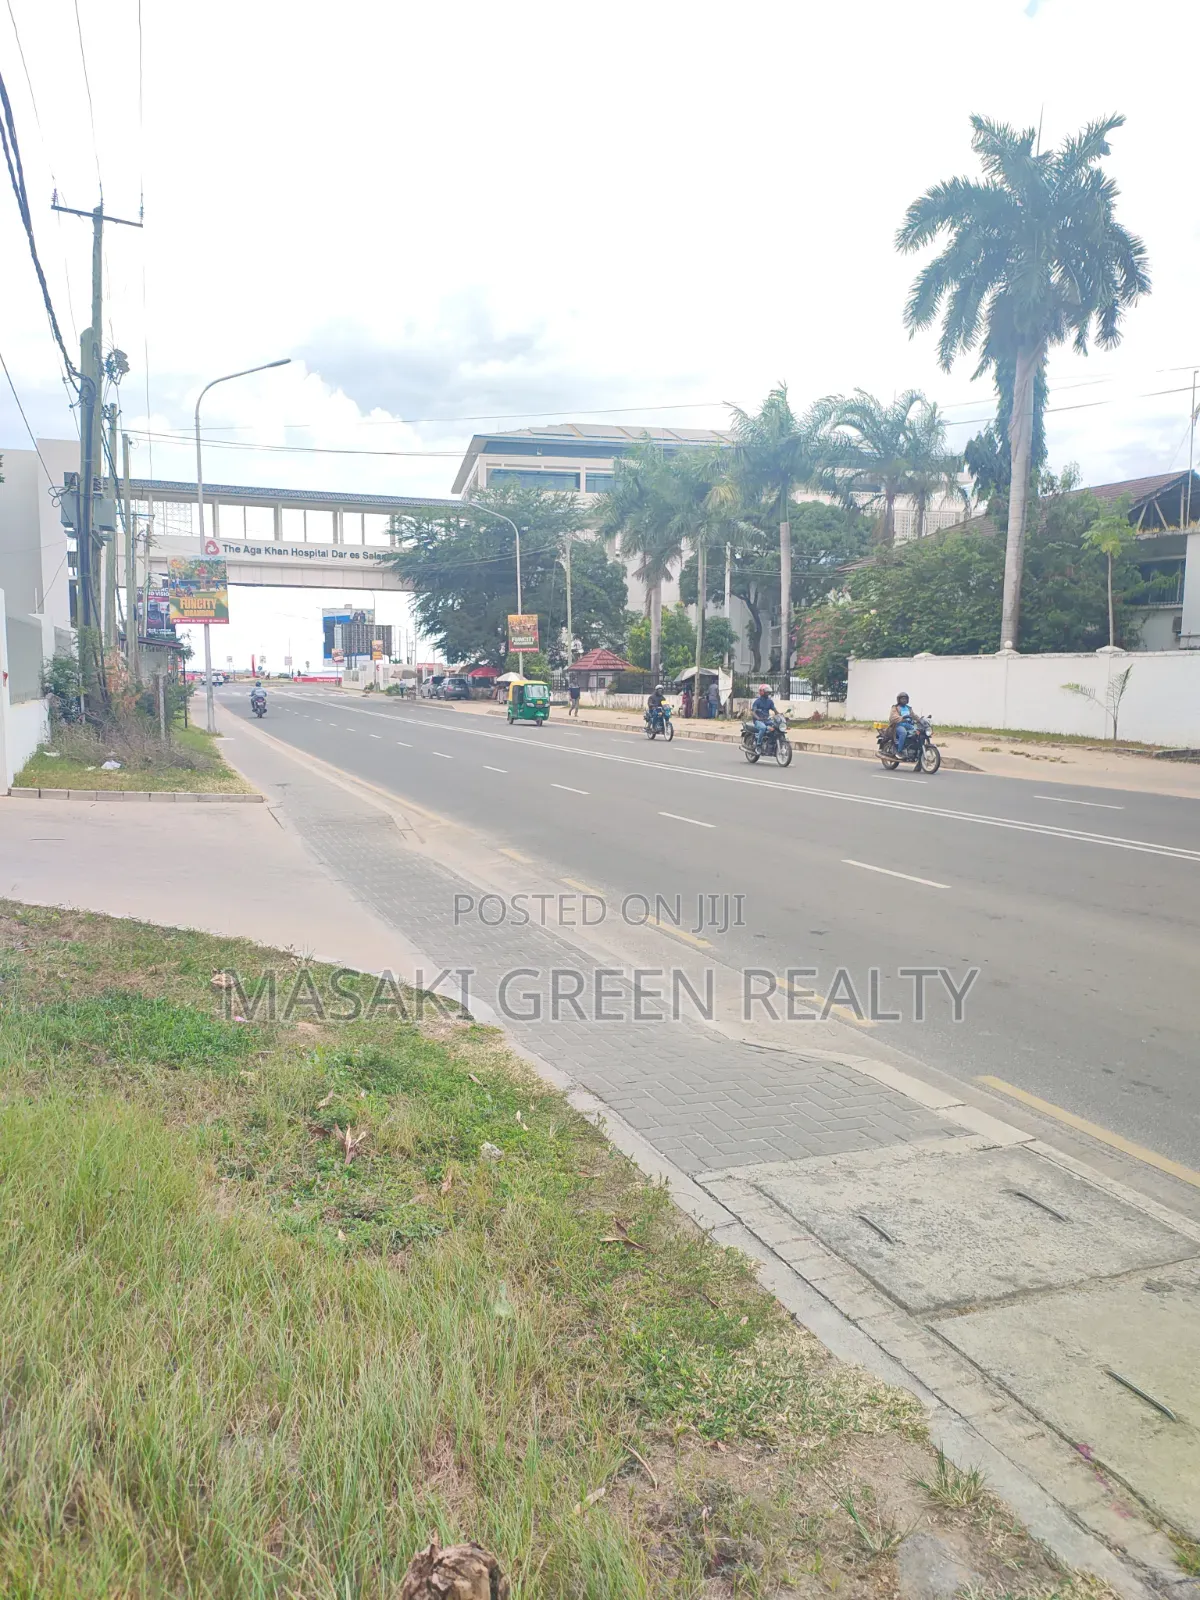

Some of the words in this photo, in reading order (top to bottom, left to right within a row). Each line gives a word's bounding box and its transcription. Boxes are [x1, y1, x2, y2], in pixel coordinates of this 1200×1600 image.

[222, 544, 240, 553] The
[243, 545, 261, 556] Aga
[264, 546, 288, 556] Khan
[291, 547, 328, 559] Hospital
[331, 549, 347, 558] Dar
[350, 551, 359, 559] es
[180, 597, 217, 610] FUNCITY
